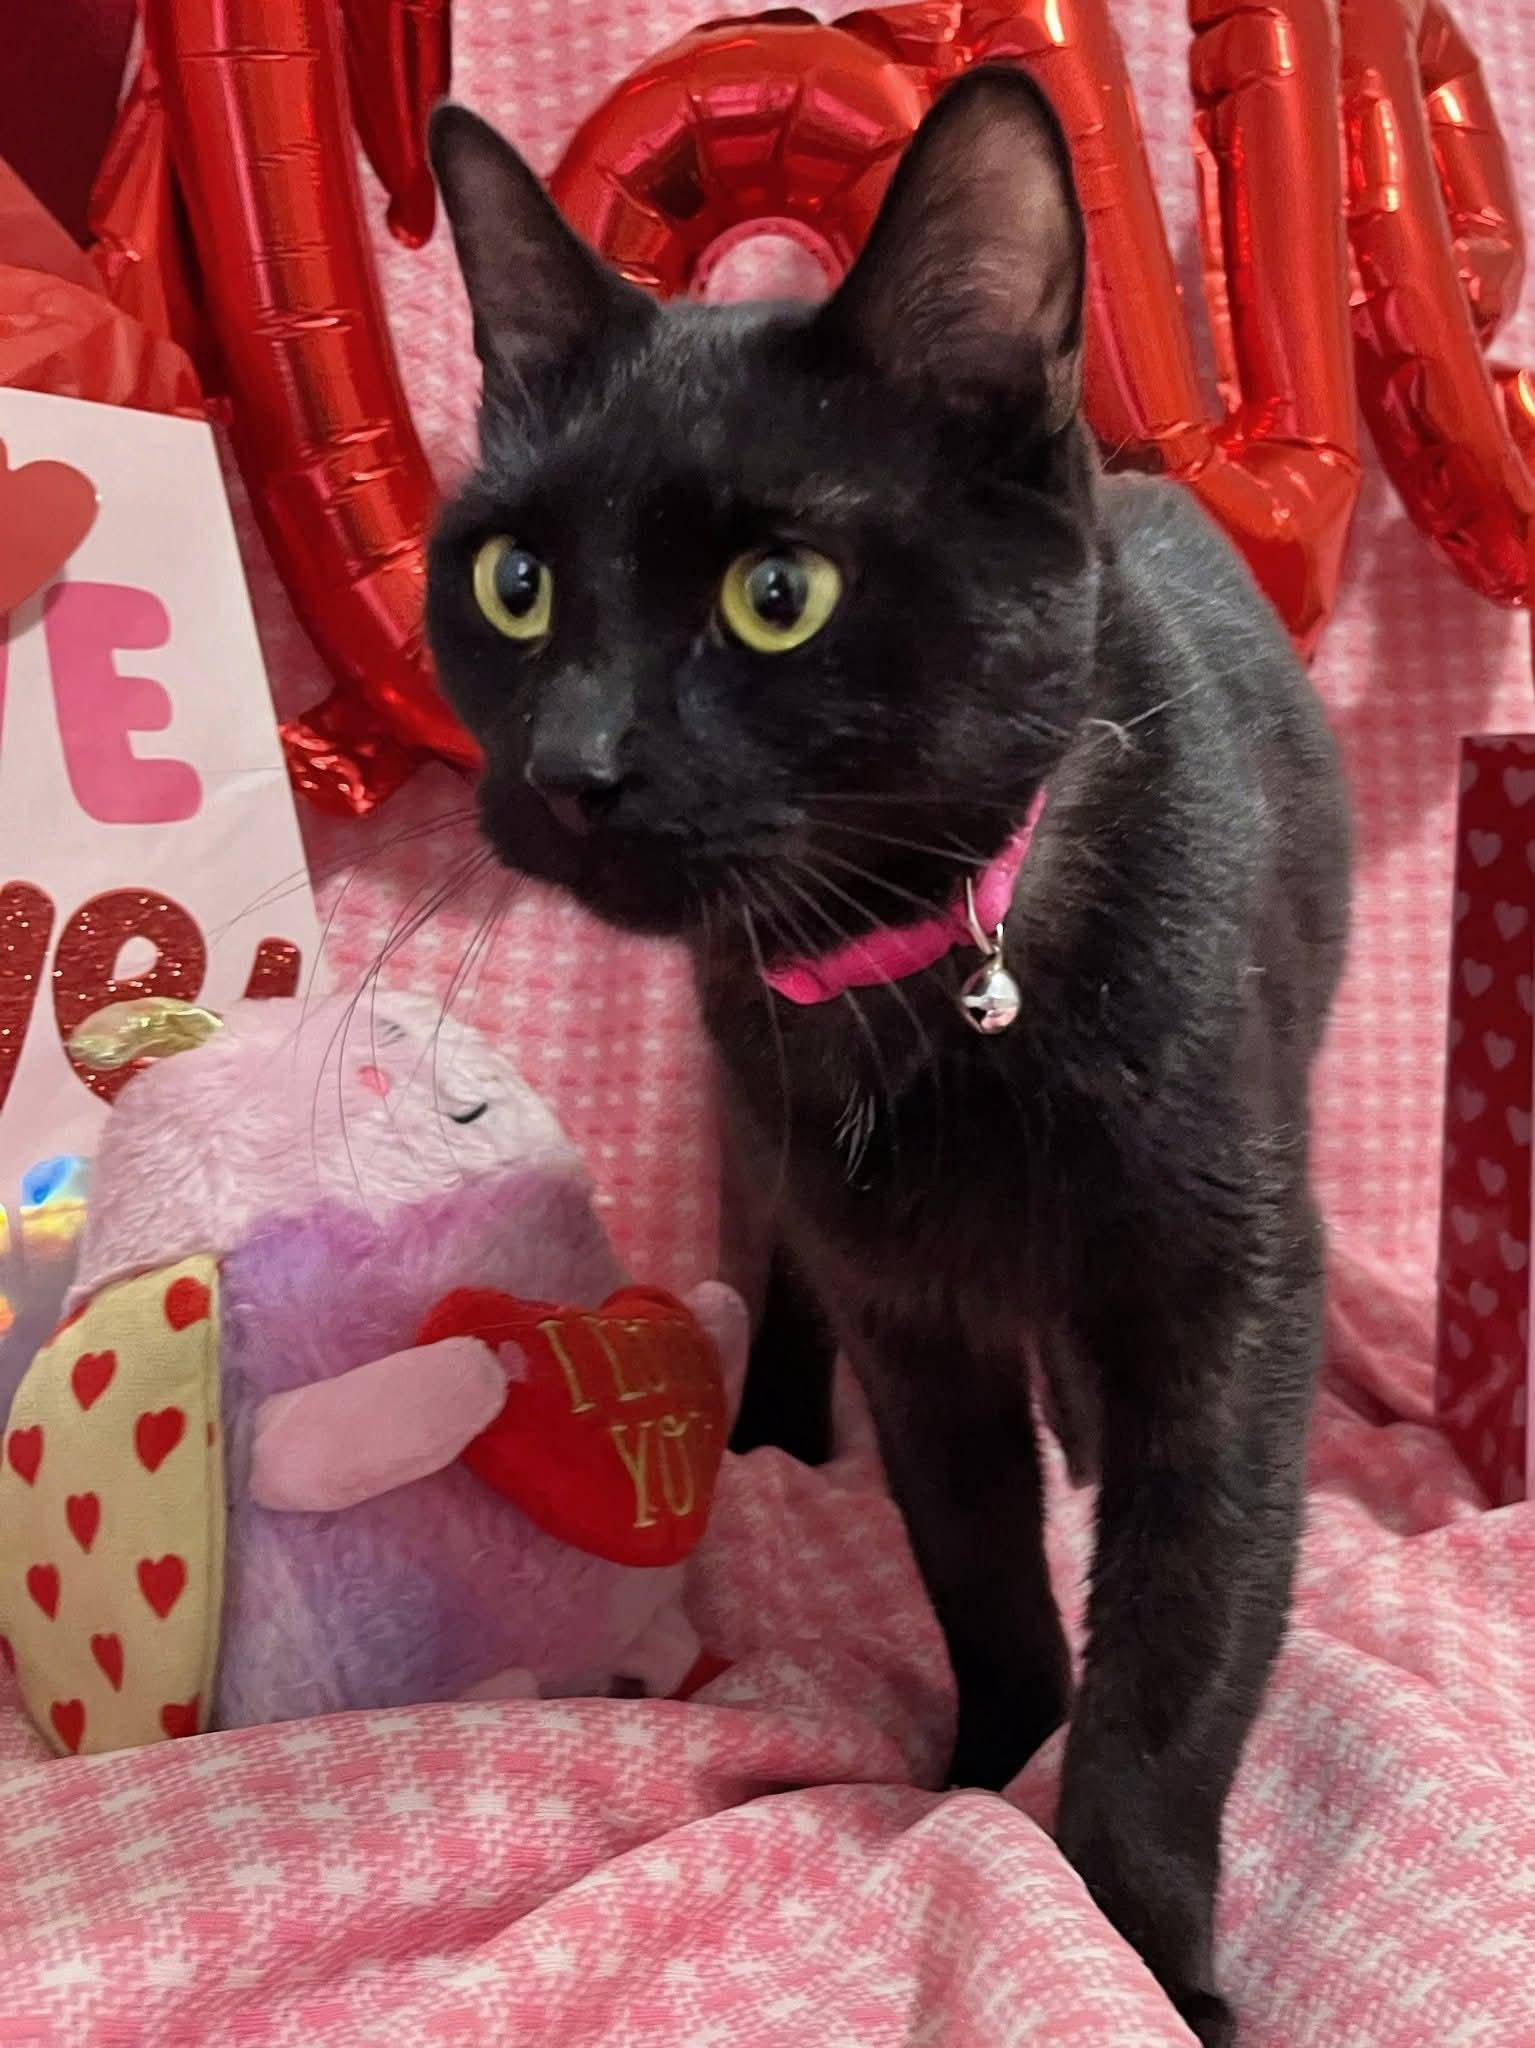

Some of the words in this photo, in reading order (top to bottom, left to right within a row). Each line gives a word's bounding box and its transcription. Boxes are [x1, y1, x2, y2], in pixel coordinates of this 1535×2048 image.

[0, 581, 204, 825] E
[537, 1319, 596, 1414] I
[608, 1408, 716, 1528] YO
